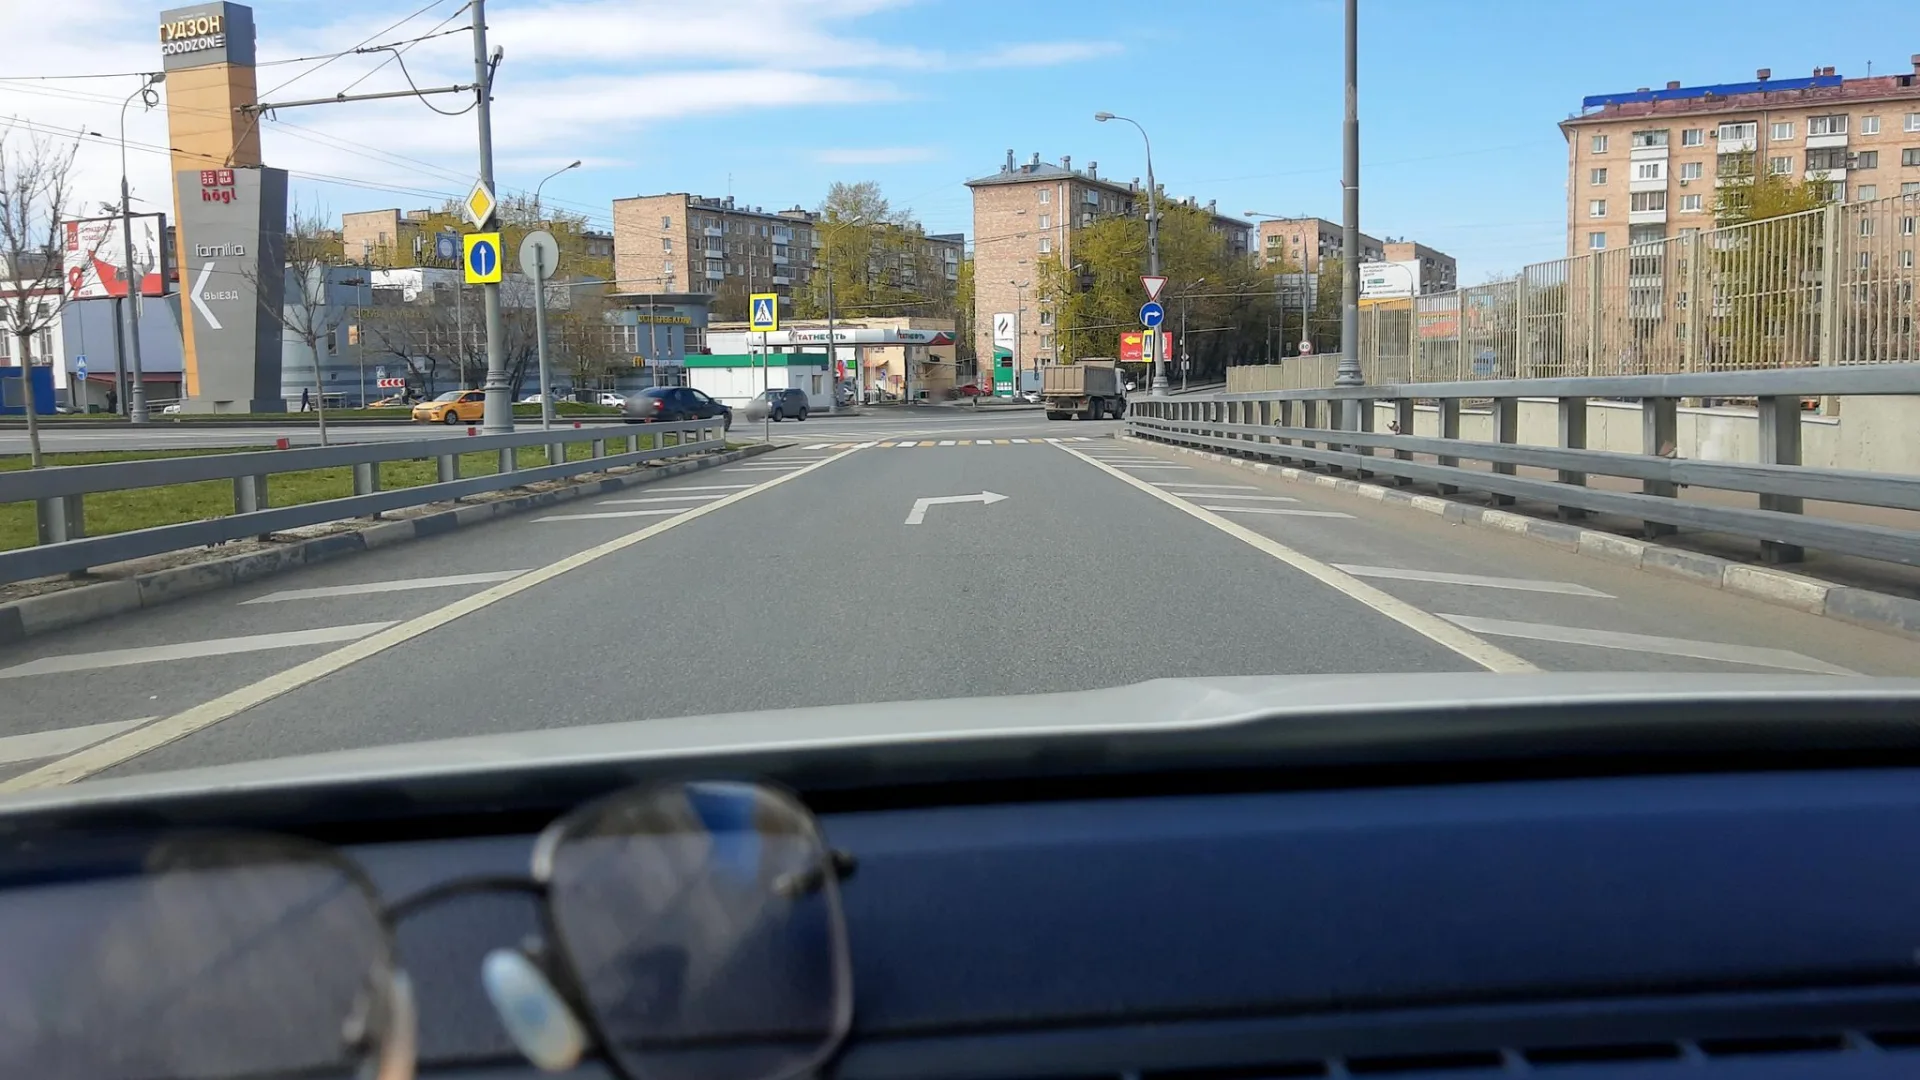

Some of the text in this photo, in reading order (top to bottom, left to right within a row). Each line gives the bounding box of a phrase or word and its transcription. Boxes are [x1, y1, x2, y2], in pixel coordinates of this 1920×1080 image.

[159, 15, 221, 41] ГУДЗОН
[160, 35, 223, 55] GOODZONE
[195, 242, 245, 257] familia
[203, 290, 239, 301] ВЫЕЗД
